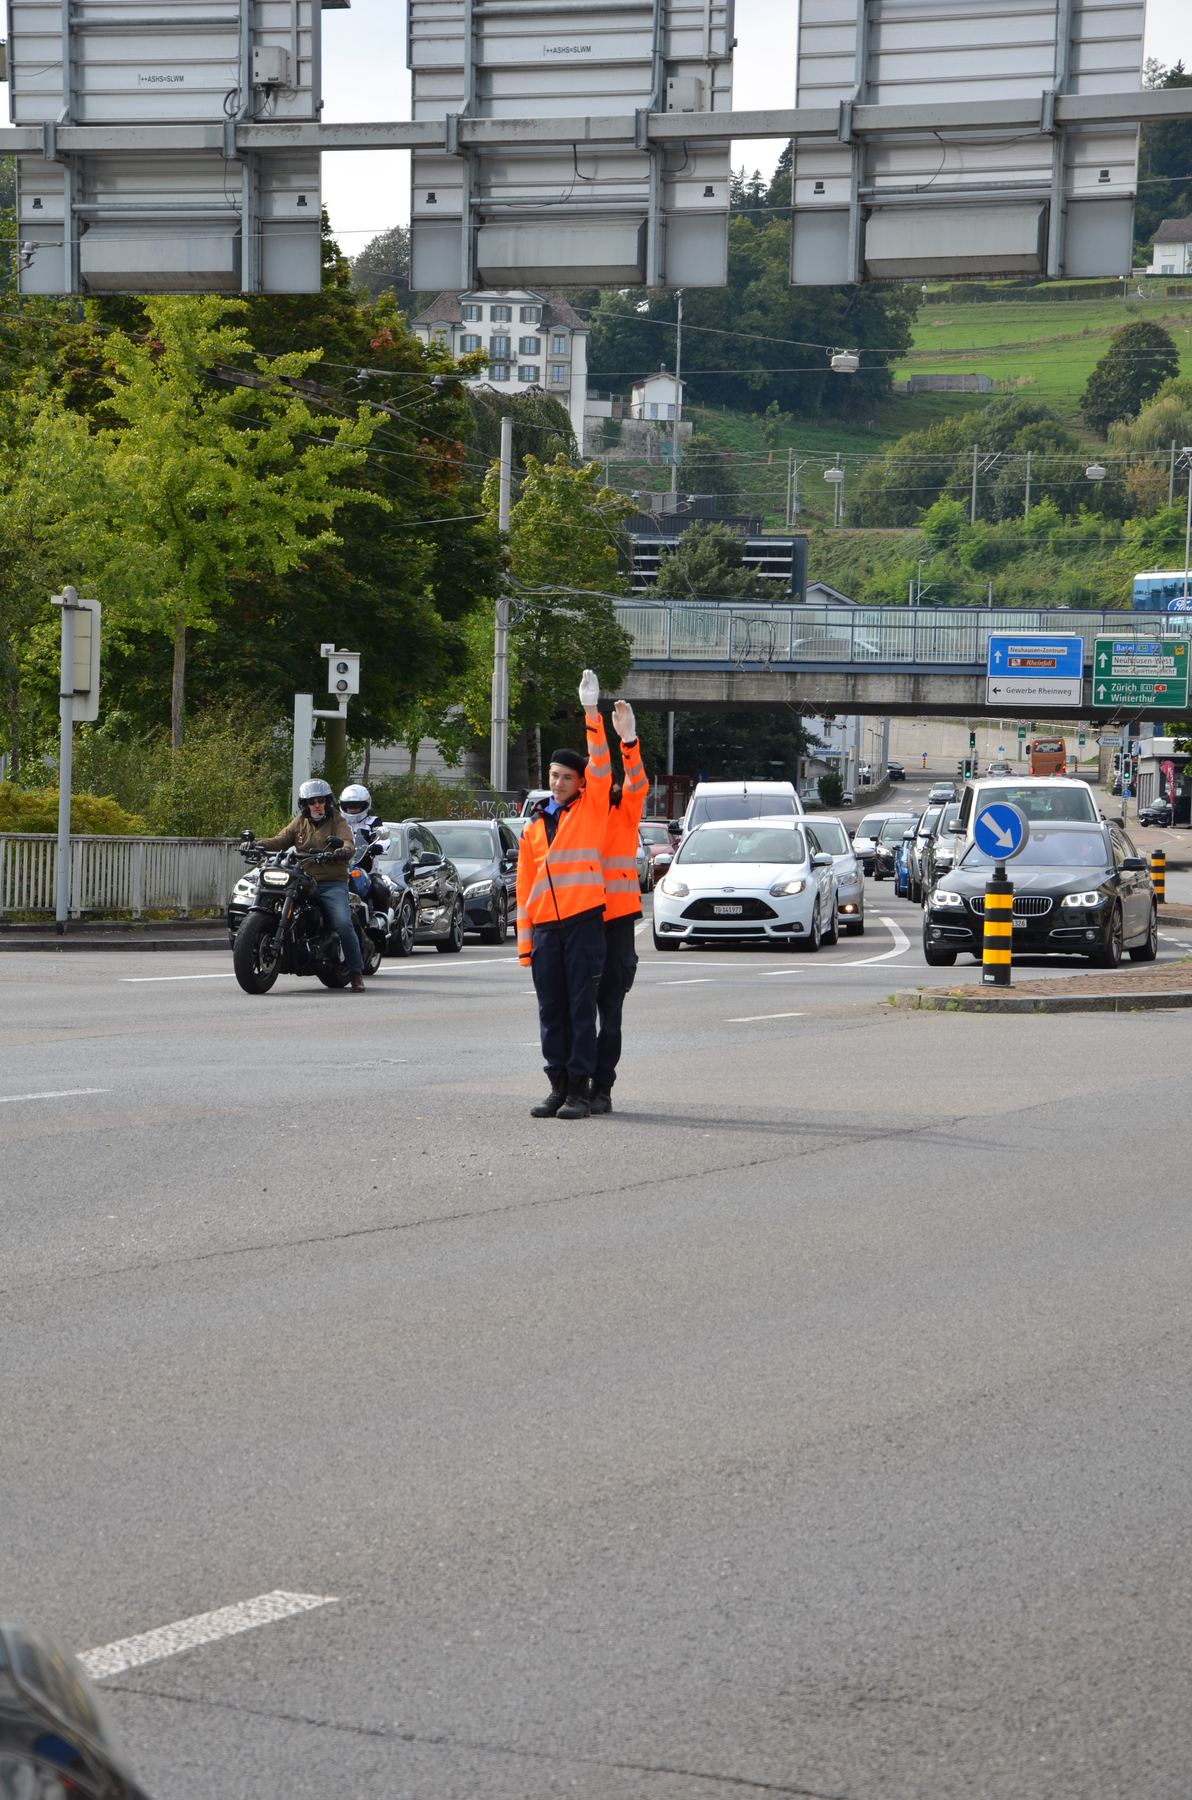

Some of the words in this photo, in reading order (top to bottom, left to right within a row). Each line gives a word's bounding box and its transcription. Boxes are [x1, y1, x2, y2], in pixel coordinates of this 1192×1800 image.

[1005, 686, 1037, 695] Gewerbe
[1038, 687, 1073, 697] Rheinweg
[1111, 682, 1137, 692] Zürich
[1111, 693, 1157, 703] Winterthur
